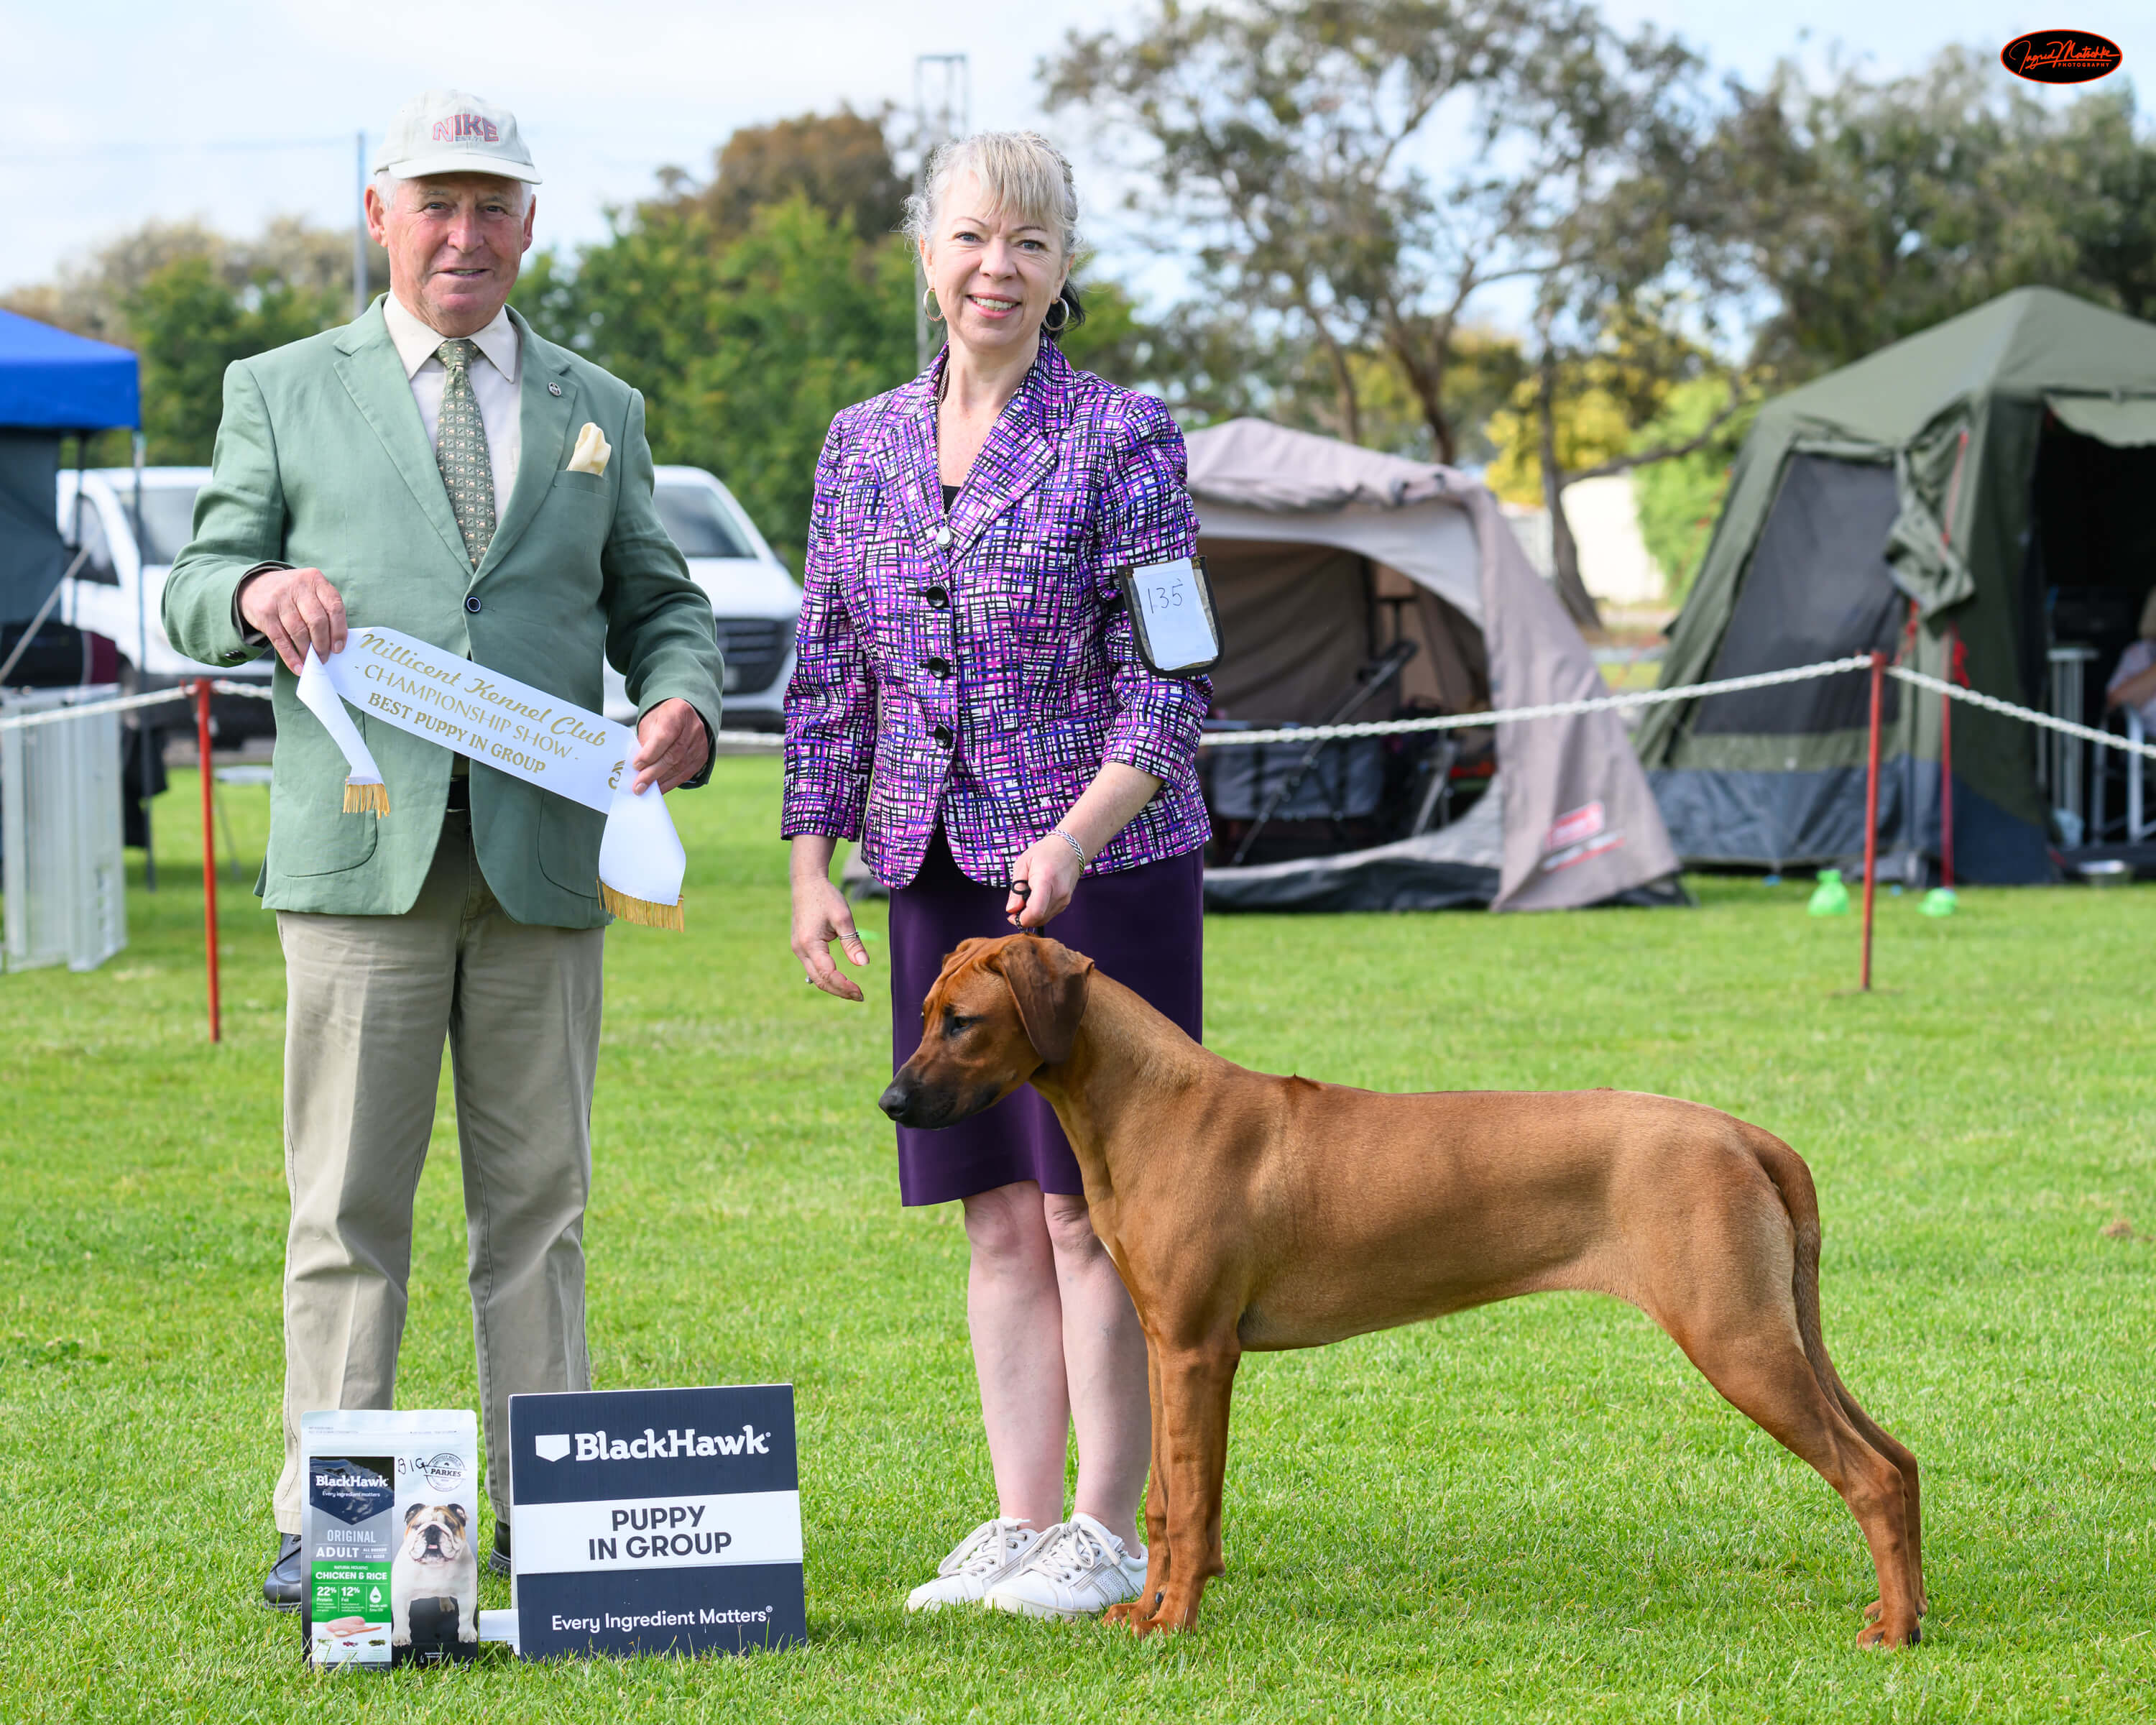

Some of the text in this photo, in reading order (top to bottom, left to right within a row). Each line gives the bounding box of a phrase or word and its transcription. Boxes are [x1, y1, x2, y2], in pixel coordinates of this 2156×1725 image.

[433, 114, 499, 142] NIKE
[1148, 578, 1184, 615] 135
[364, 663, 512, 733] CHAMPIONSHIP
[512, 724, 573, 759] SHOW
[464, 678, 553, 724] Kennel
[550, 717, 607, 747] Club
[367, 691, 546, 774] BEST PUPPY IN GROUP
[430, 1468, 462, 1477] PARKES
[612, 1506, 706, 1532] PUPPY
[327, 1529, 377, 1543] ORIGINAL
[589, 1532, 732, 1560] IN GROUP
[316, 1547, 359, 1558] ADULT
[315, 1571, 356, 1580] CHICKEN
[317, 1586, 337, 1596] 22%
[341, 1586, 360, 1596] 12%
[552, 1615, 601, 1633] Every
[605, 1612, 695, 1632] Ingredient
